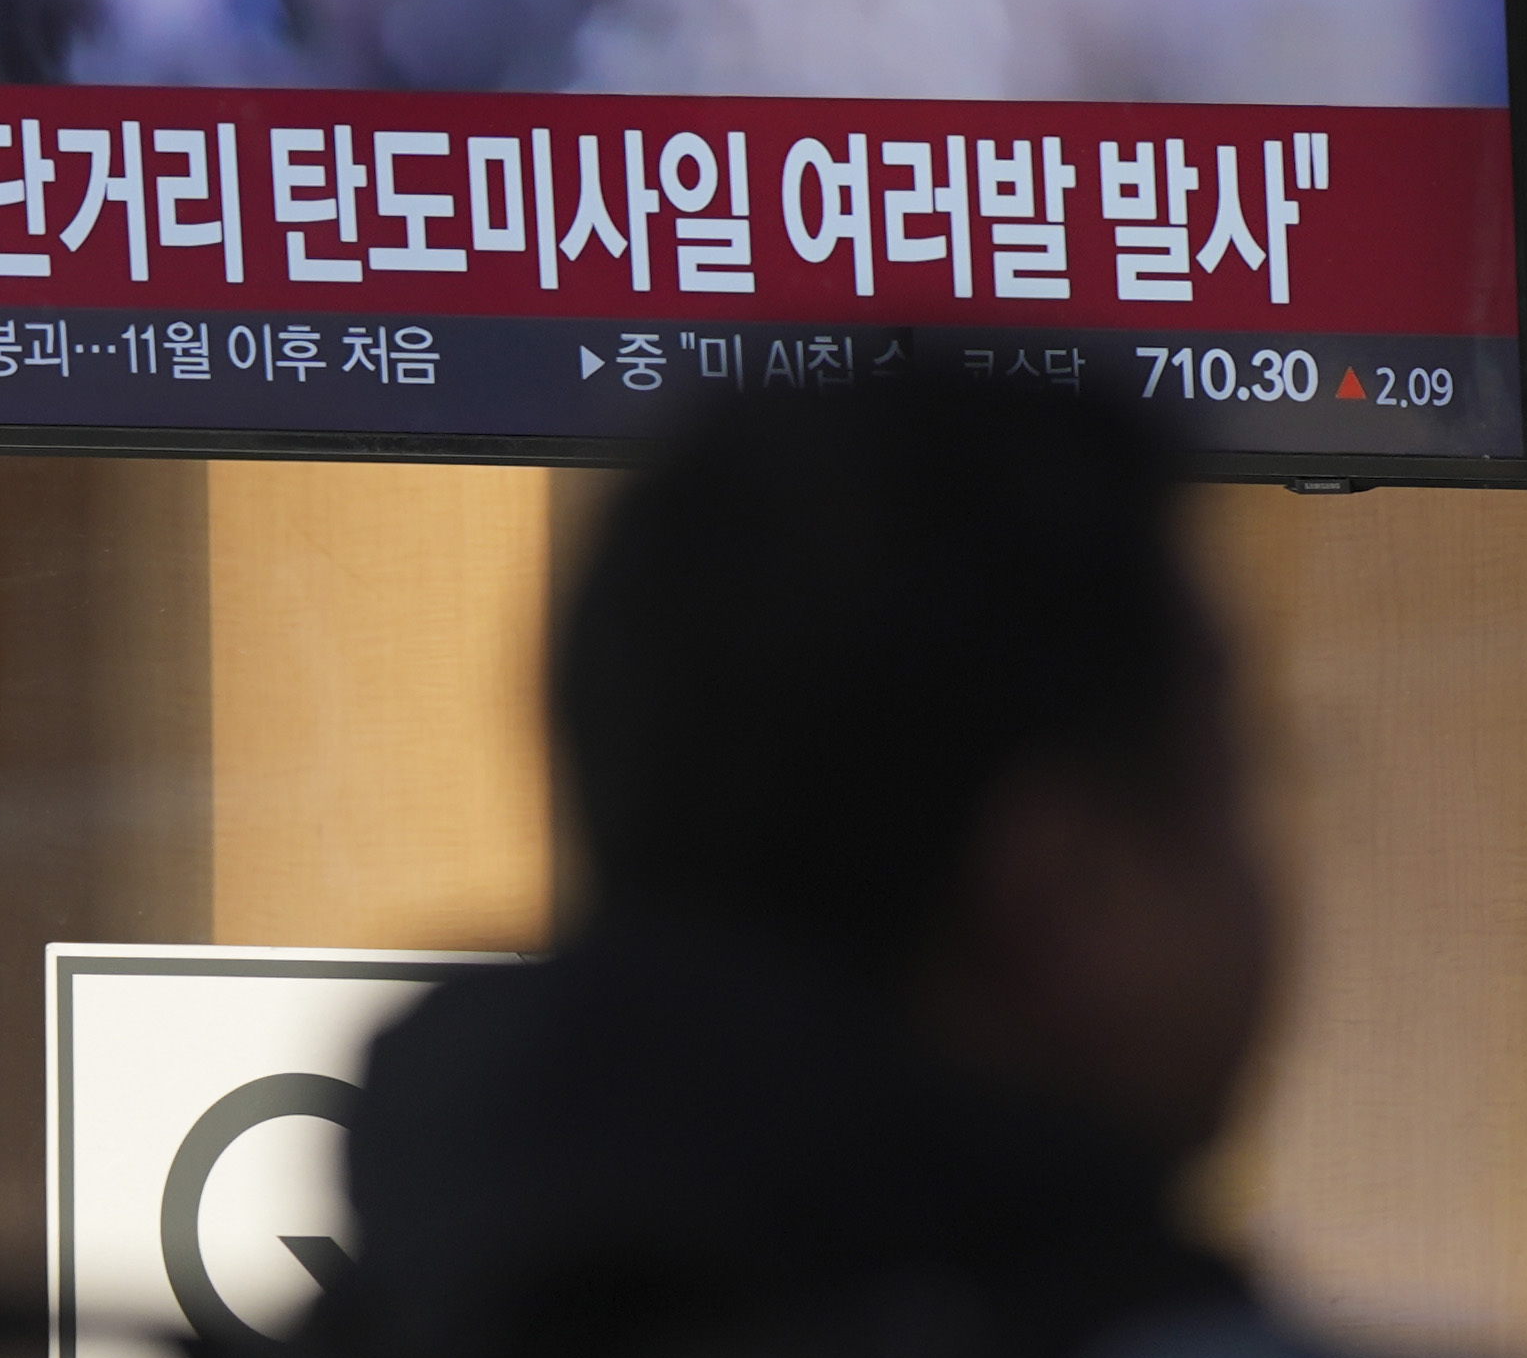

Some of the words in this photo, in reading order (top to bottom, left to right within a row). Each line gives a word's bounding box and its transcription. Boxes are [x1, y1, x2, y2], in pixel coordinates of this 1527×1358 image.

[270, 124, 756, 294] 탄도미사일
[781, 132, 1077, 300] 여러발
[1099, 132, 1329, 304] 발사"
[228, 323, 328, 382] 이후
[341, 325, 441, 385] 처음
[1136, 347, 1319, 403] 710.30
[1375, 366, 1454, 409] 2.09
